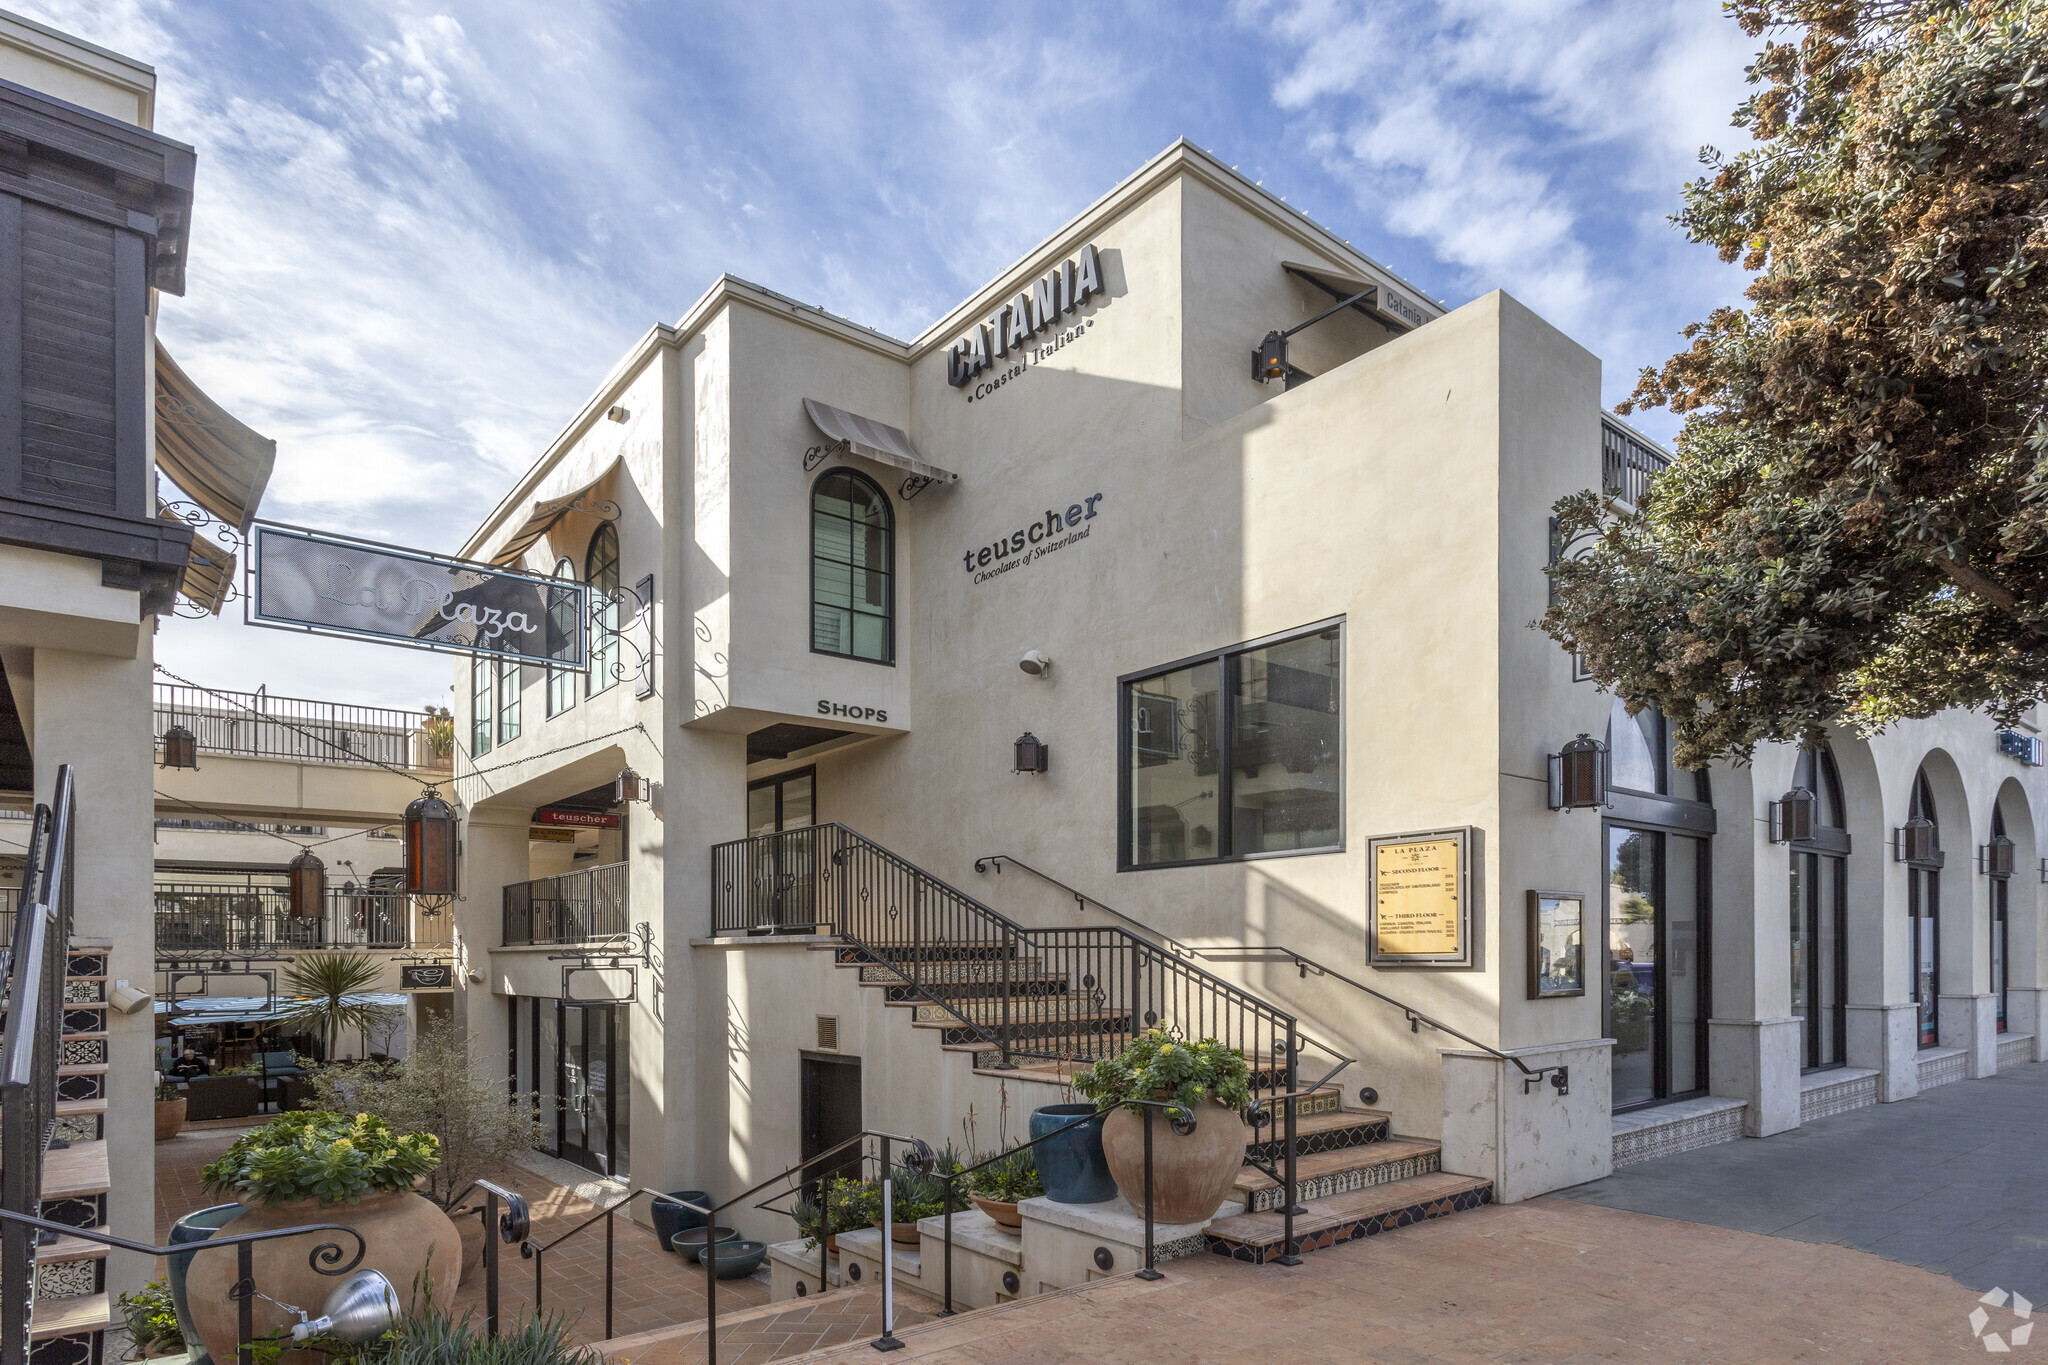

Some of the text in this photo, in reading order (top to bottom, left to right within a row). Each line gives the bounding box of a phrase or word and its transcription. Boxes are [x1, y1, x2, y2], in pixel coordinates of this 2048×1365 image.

[947, 243, 1105, 388] CATANIA
[1386, 292, 1422, 326] Catania
[974, 324, 1086, 401] Coastal Italian
[963, 492, 1103, 573] teuscher
[973, 524, 1091, 585] Chocolates of Switzerland
[320, 561, 538, 638] La Plaza
[817, 699, 888, 723] SHOPS
[552, 812, 608, 824] teuscher
[1408, 845, 1437, 853] PLAZA
